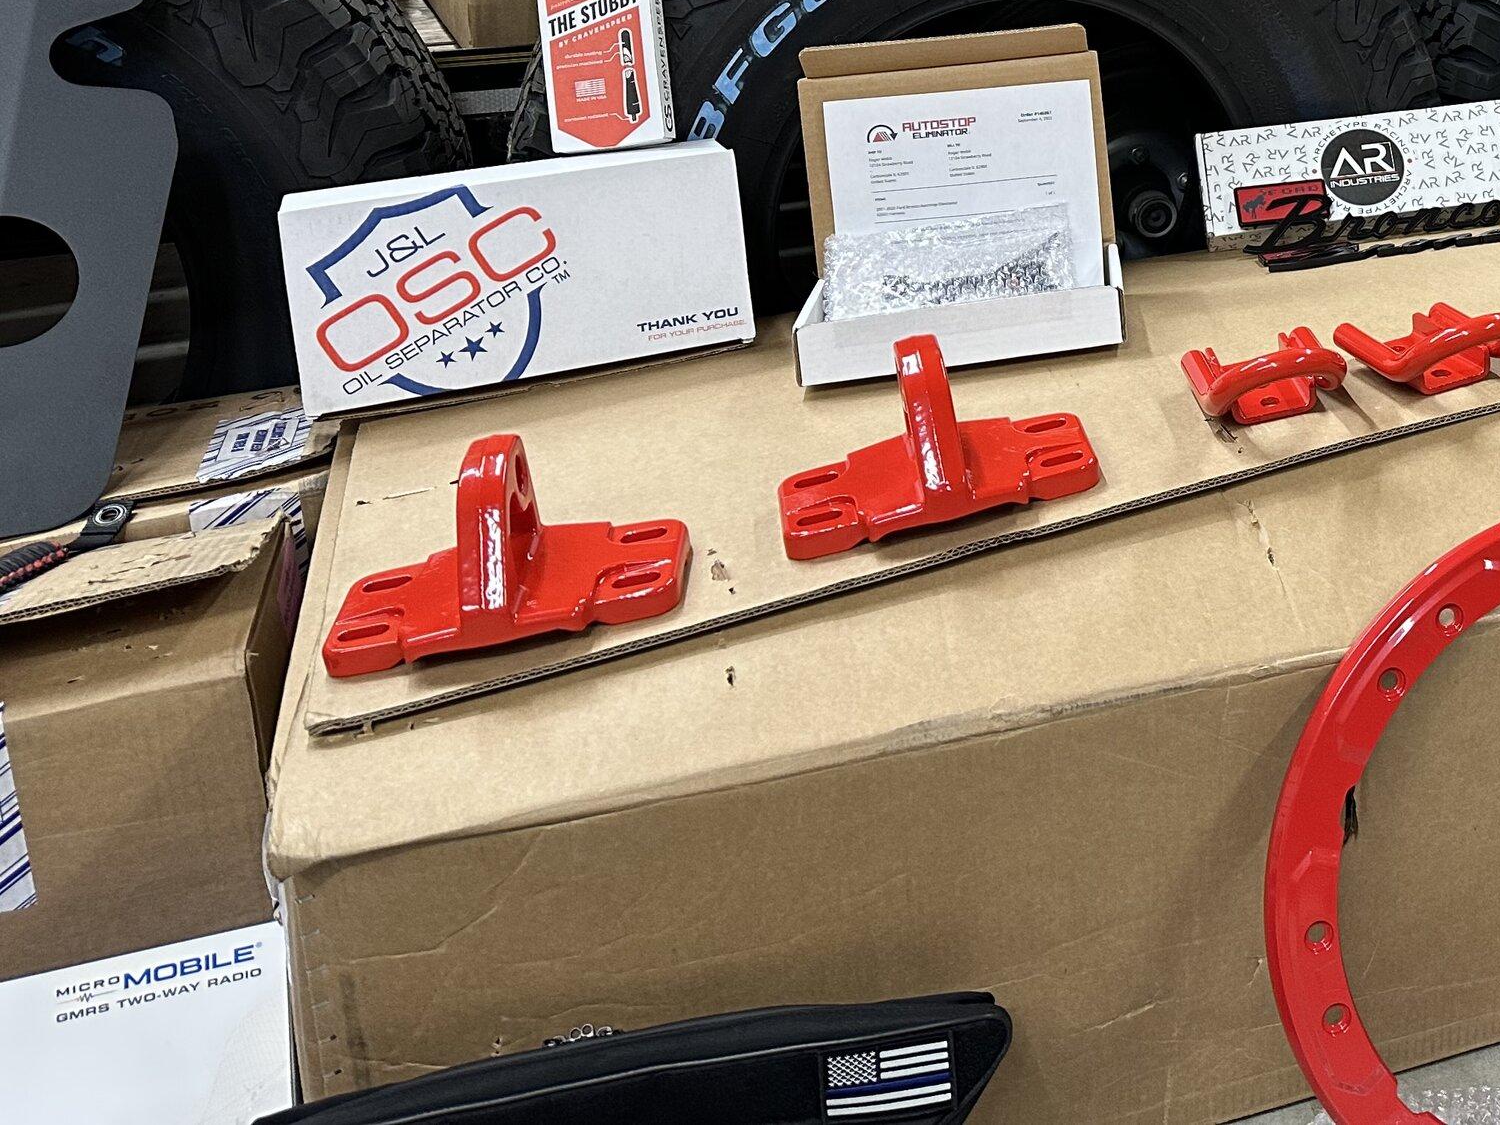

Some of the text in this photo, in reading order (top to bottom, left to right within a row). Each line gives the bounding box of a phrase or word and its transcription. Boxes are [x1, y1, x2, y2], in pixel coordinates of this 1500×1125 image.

[548, 10, 577, 37] THE
[558, 13, 633, 48] BY CRAVENSPEED
[902, 117, 977, 132] AUTOSTOP
[912, 128, 968, 140] ELIMINATOR
[1330, 142, 1396, 178] AR
[1330, 174, 1400, 189] INDUSTRIES
[366, 225, 446, 278] J&L
[316, 206, 557, 372] OSC
[342, 370, 383, 396] OIL
[385, 280, 522, 370] SEPARATOR
[525, 257, 568, 286] CO.
[636, 306, 739, 334] THANK YOU
[648, 332, 667, 342] FOR
[668, 328, 695, 339] YOUR
[56, 944, 255, 997] MICRO MOBILE
[56, 967, 262, 1023] GMRS TWO-WAY RADIO
